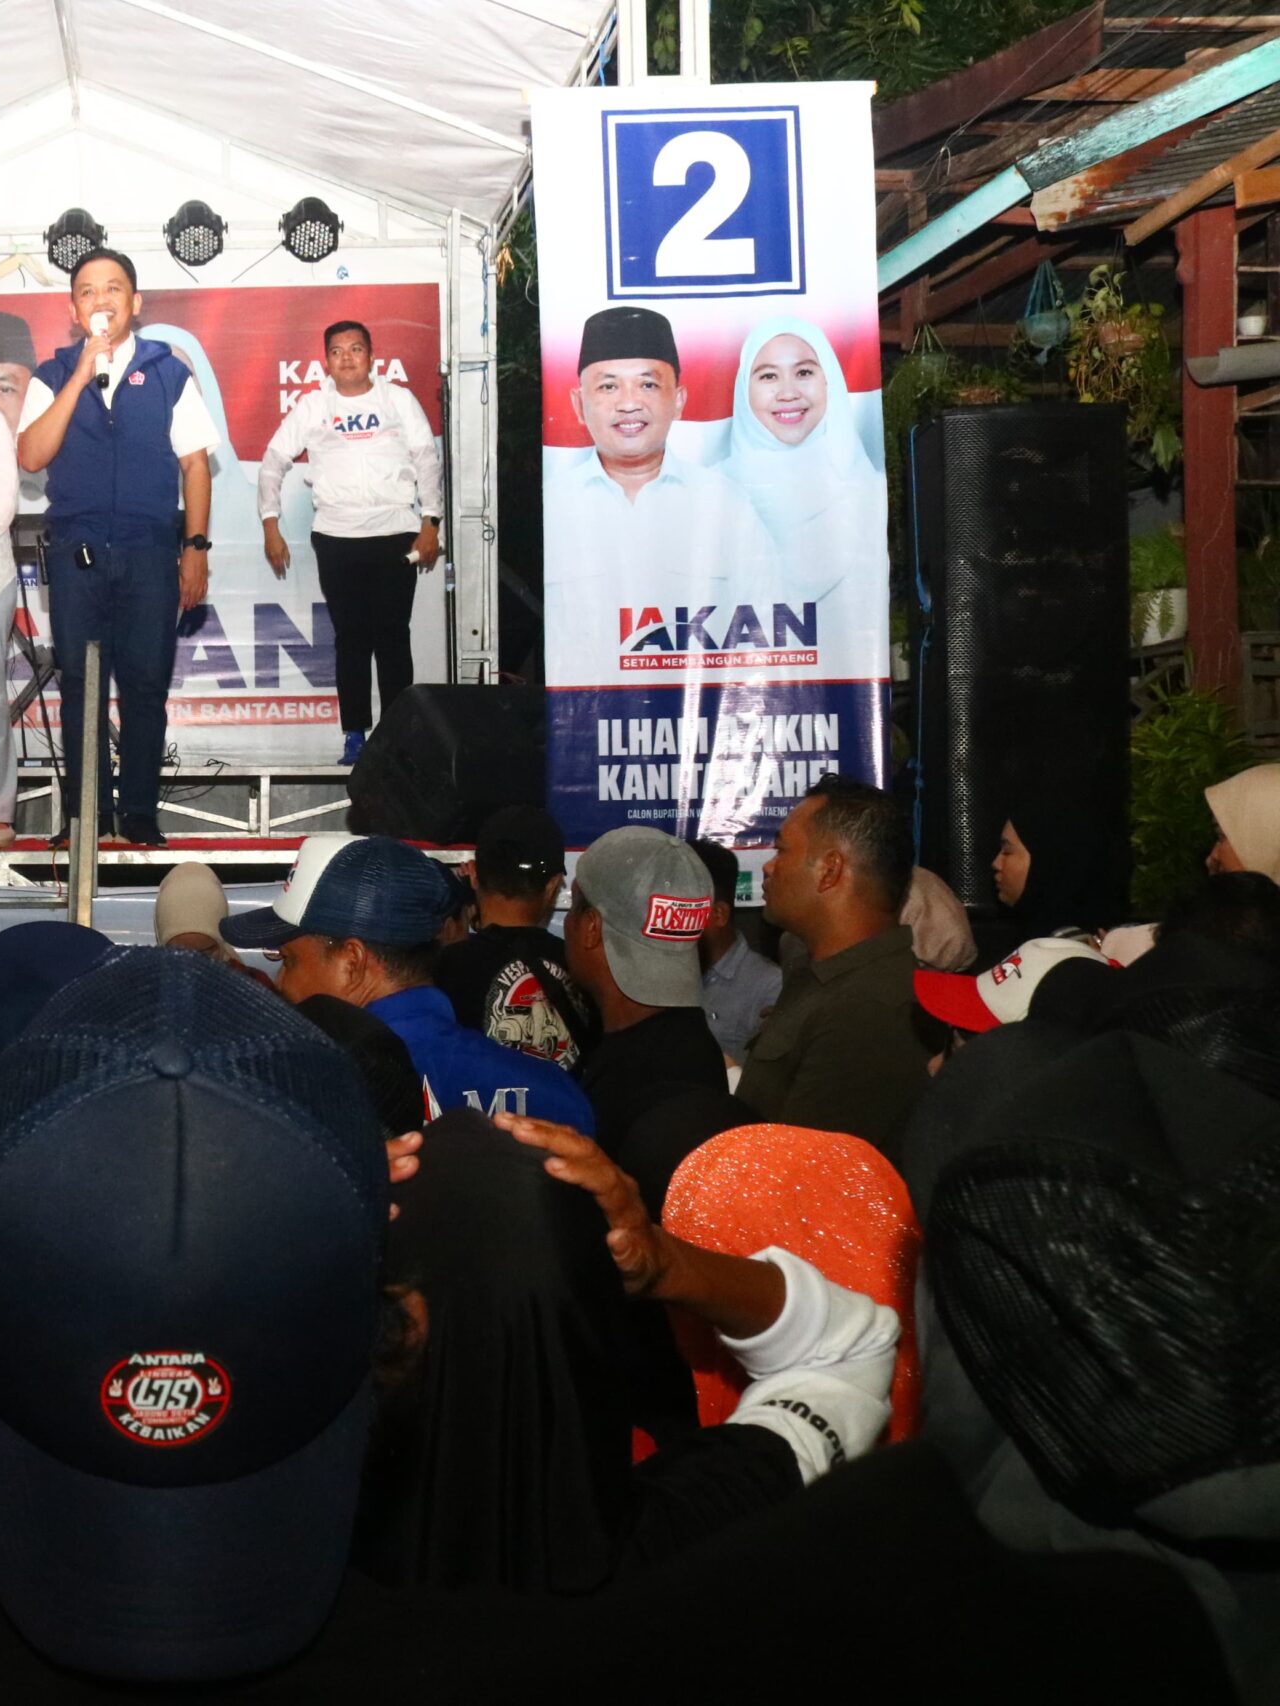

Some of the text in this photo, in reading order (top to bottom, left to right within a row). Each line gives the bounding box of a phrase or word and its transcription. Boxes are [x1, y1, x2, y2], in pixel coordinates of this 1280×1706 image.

[653, 131, 756, 277] 2
[623, 657, 658, 668] SETIA
[201, 701, 333, 721] BANTAENG
[598, 717, 708, 756] ILHAM
[627, 809, 652, 819] CALON
[128, 1353, 206, 1366] ANTARA
[119, 1412, 211, 1440] KEBAIKAN
